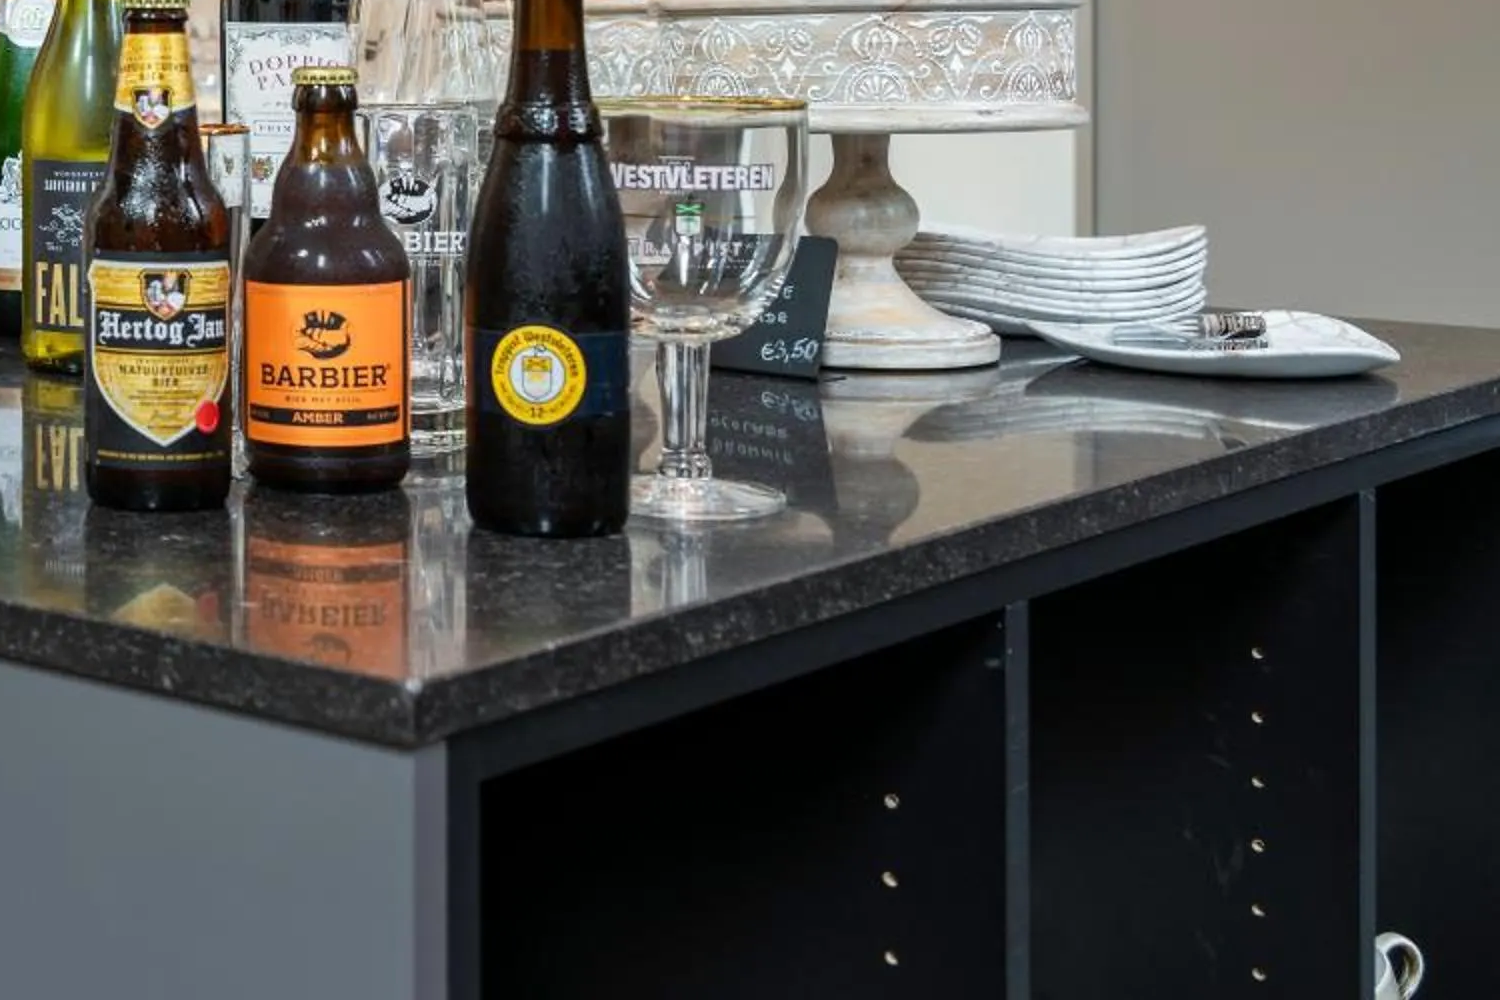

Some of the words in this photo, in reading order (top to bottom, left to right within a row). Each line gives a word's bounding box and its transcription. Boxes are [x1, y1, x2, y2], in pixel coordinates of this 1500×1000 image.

[404, 231, 466, 252] BIER
[35, 262, 84, 327] FAL
[99, 311, 184, 345] Hertog
[186, 313, 224, 347] Jan
[761, 338, 818, 363] €3,50
[260, 362, 387, 389] BARBIER
[292, 410, 344, 424] AMBER
